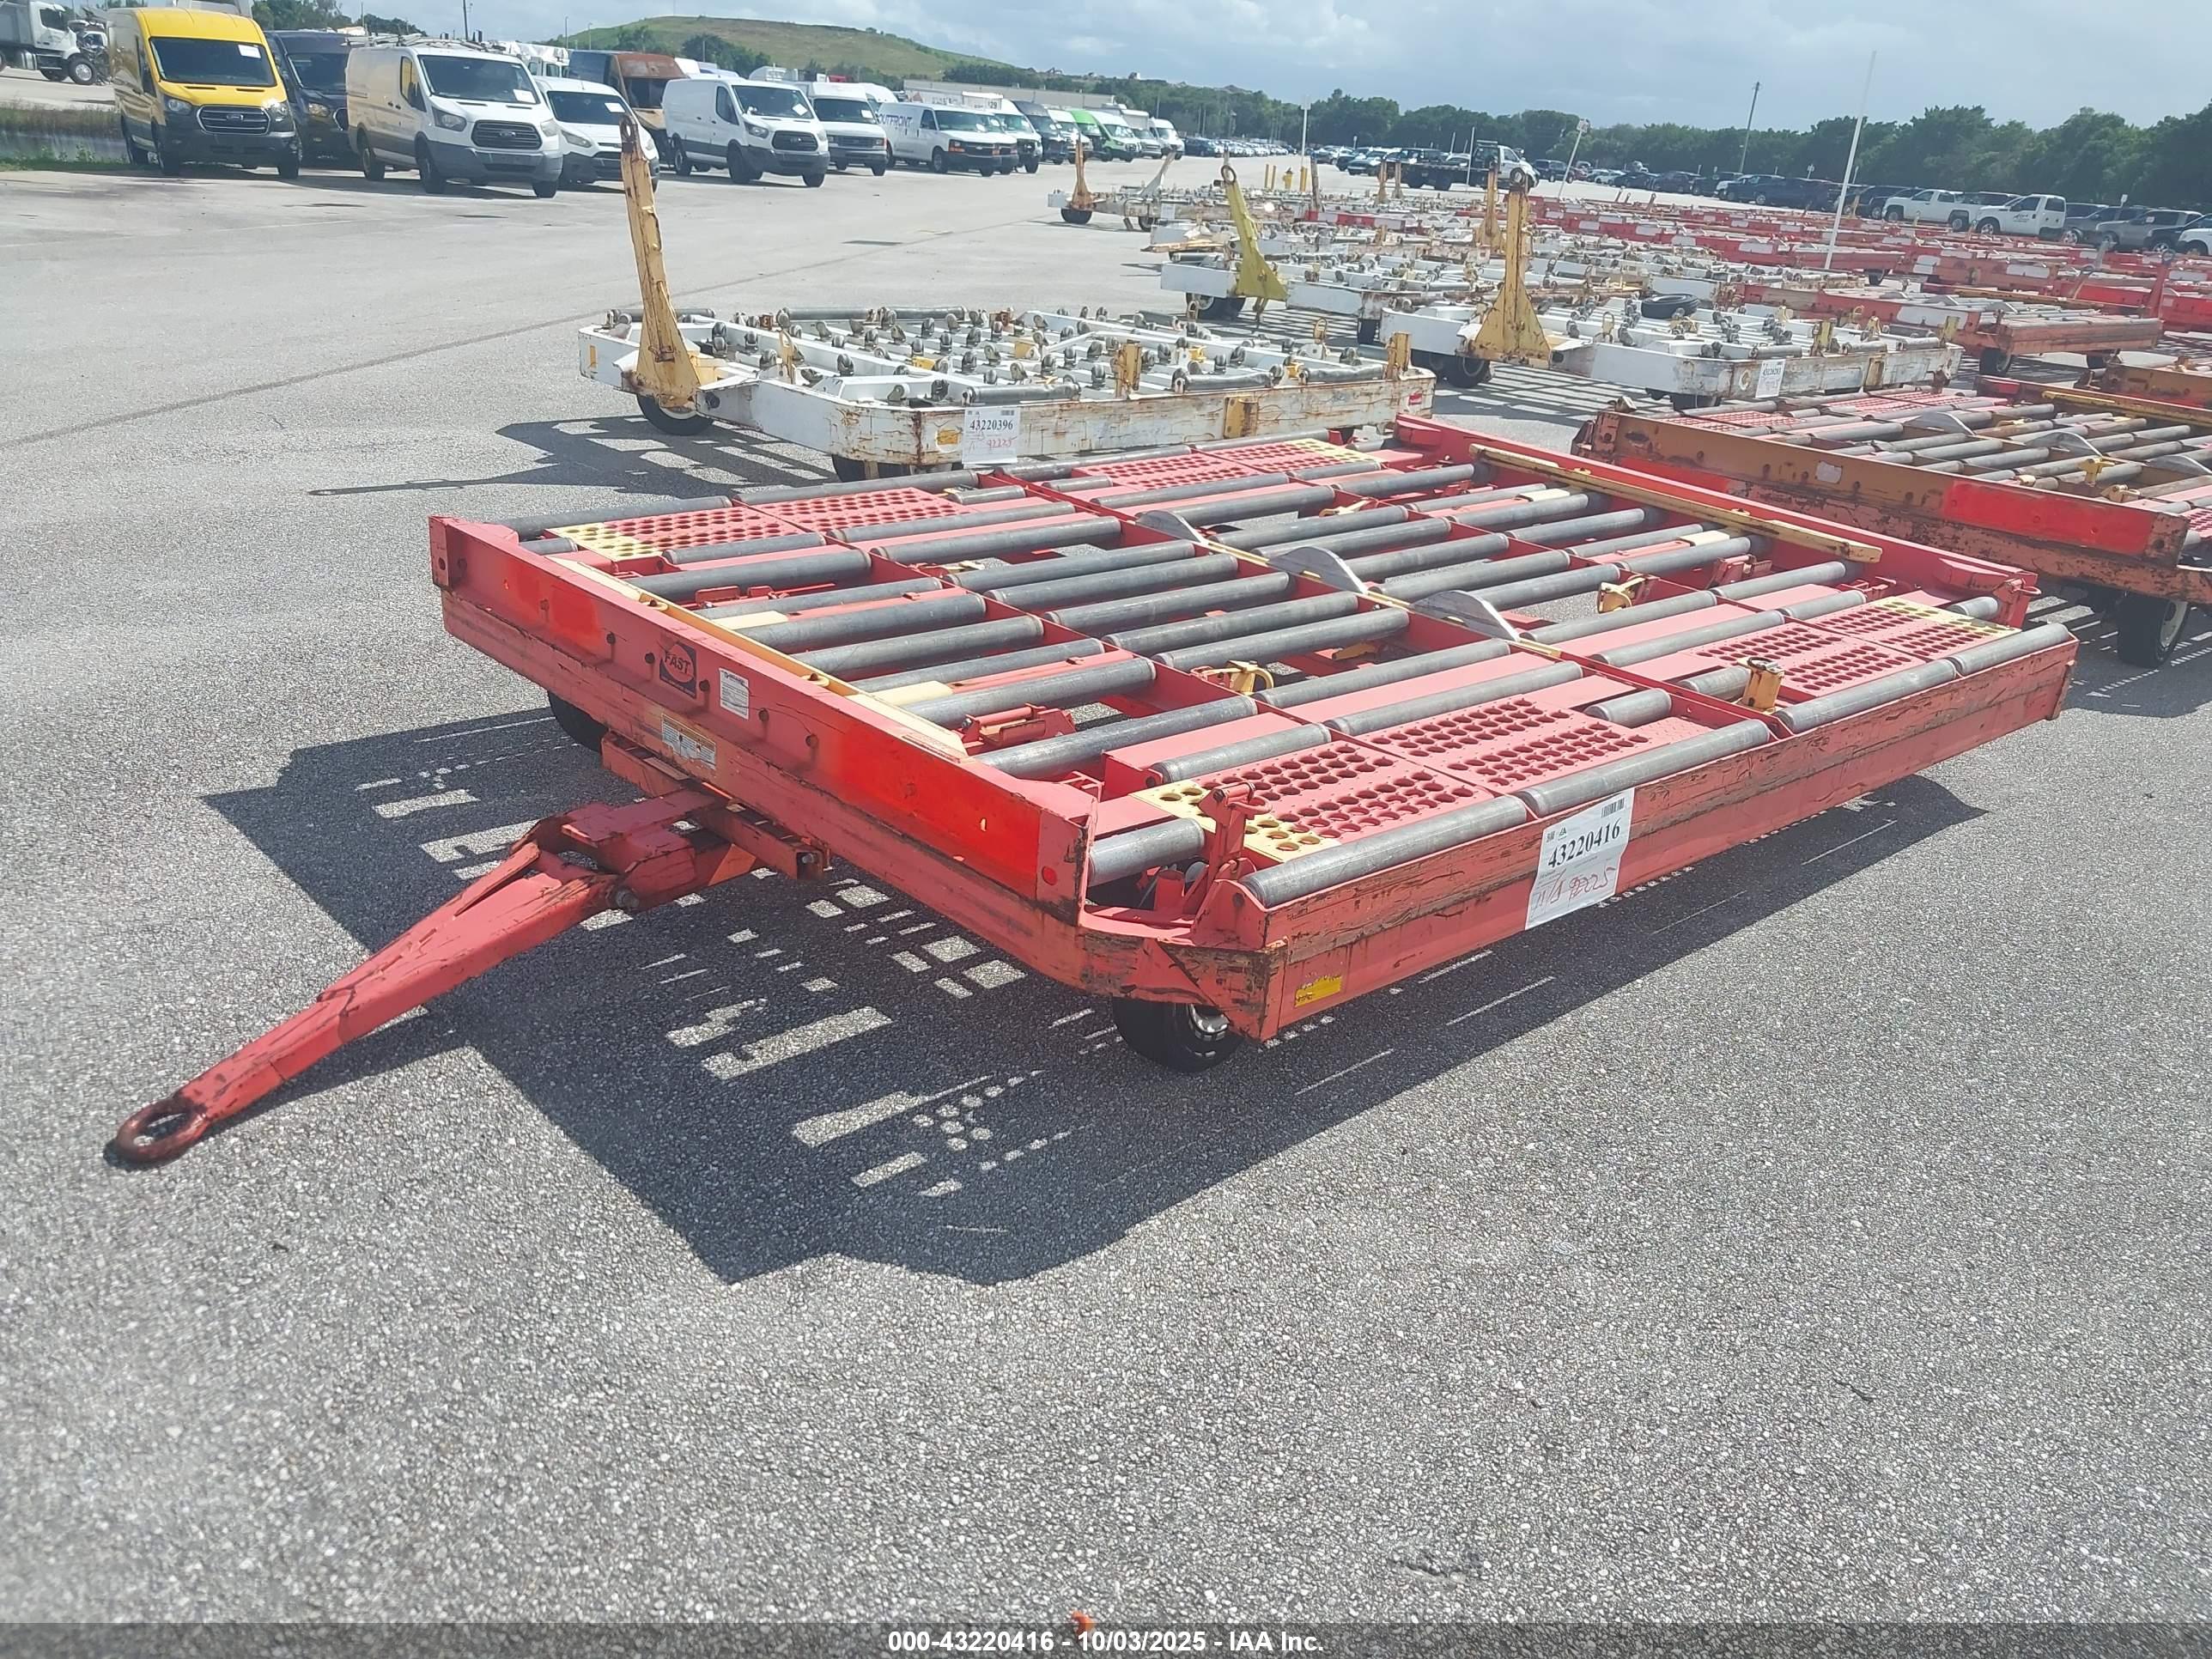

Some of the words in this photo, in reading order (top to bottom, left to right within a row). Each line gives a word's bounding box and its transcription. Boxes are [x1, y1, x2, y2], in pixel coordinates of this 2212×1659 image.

[969, 420, 1013, 431] 43220396
[665, 653, 691, 674] FAST
[1547, 817, 1622, 868] 43220416
